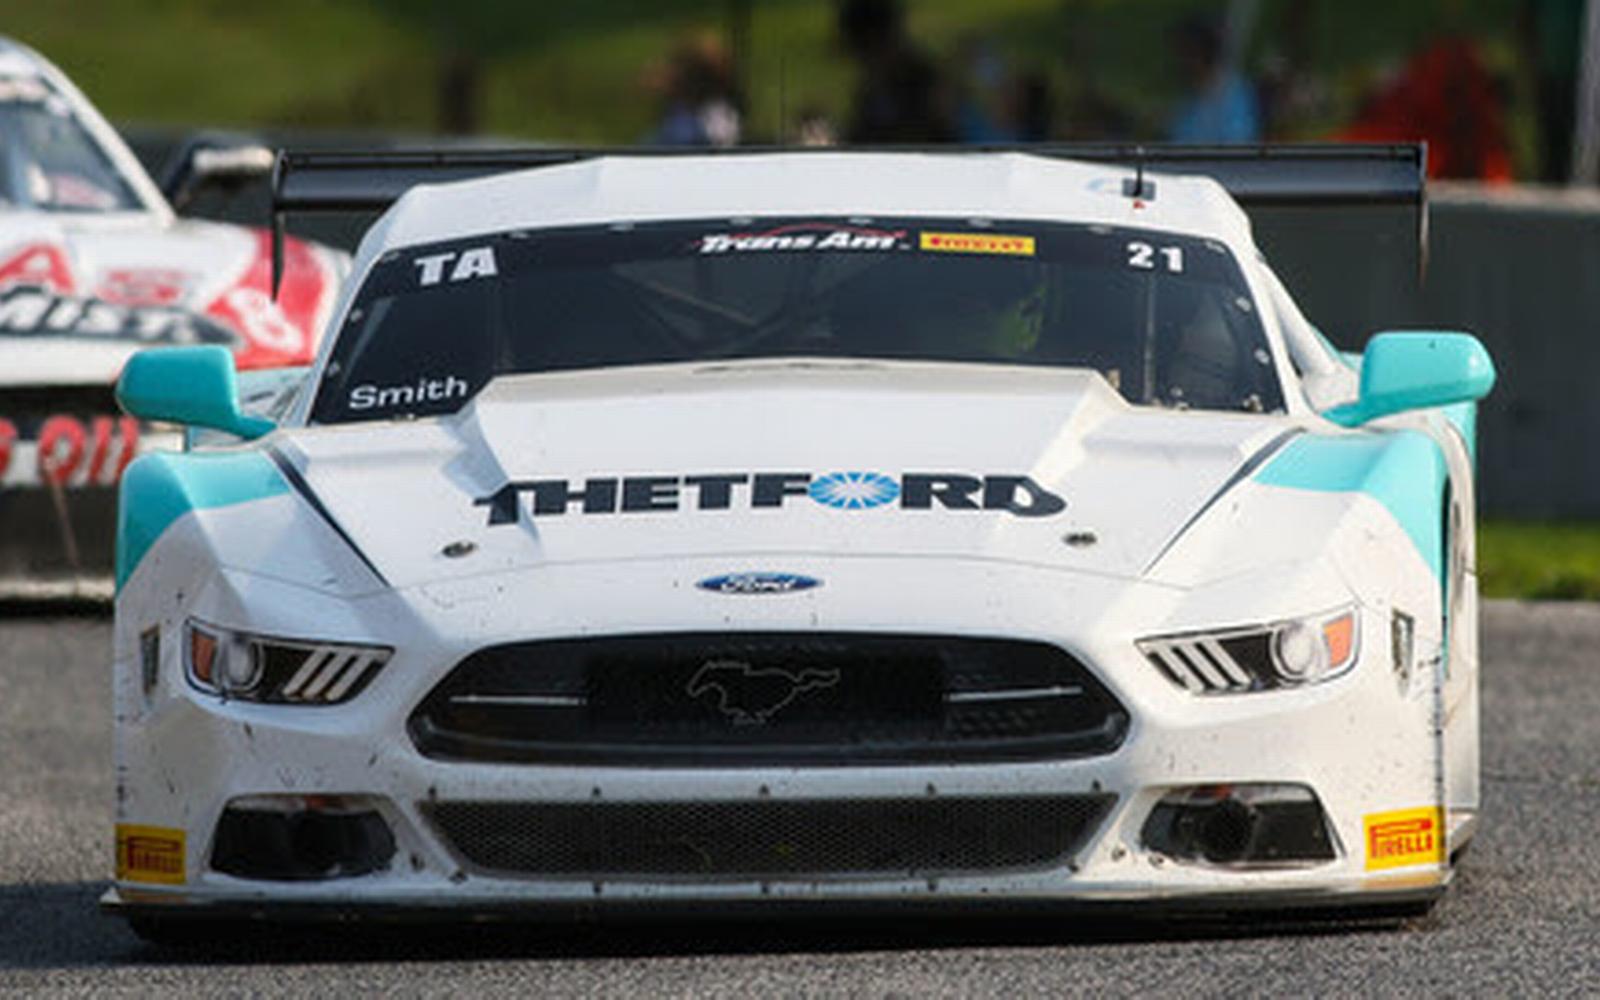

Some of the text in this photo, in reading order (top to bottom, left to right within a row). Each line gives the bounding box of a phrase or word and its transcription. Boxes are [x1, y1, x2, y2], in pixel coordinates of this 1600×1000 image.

[414, 247, 499, 287] TA
[1126, 240, 1184, 273] 21
[350, 377, 468, 409] Smith
[472, 472, 1067, 526] THETFORD
